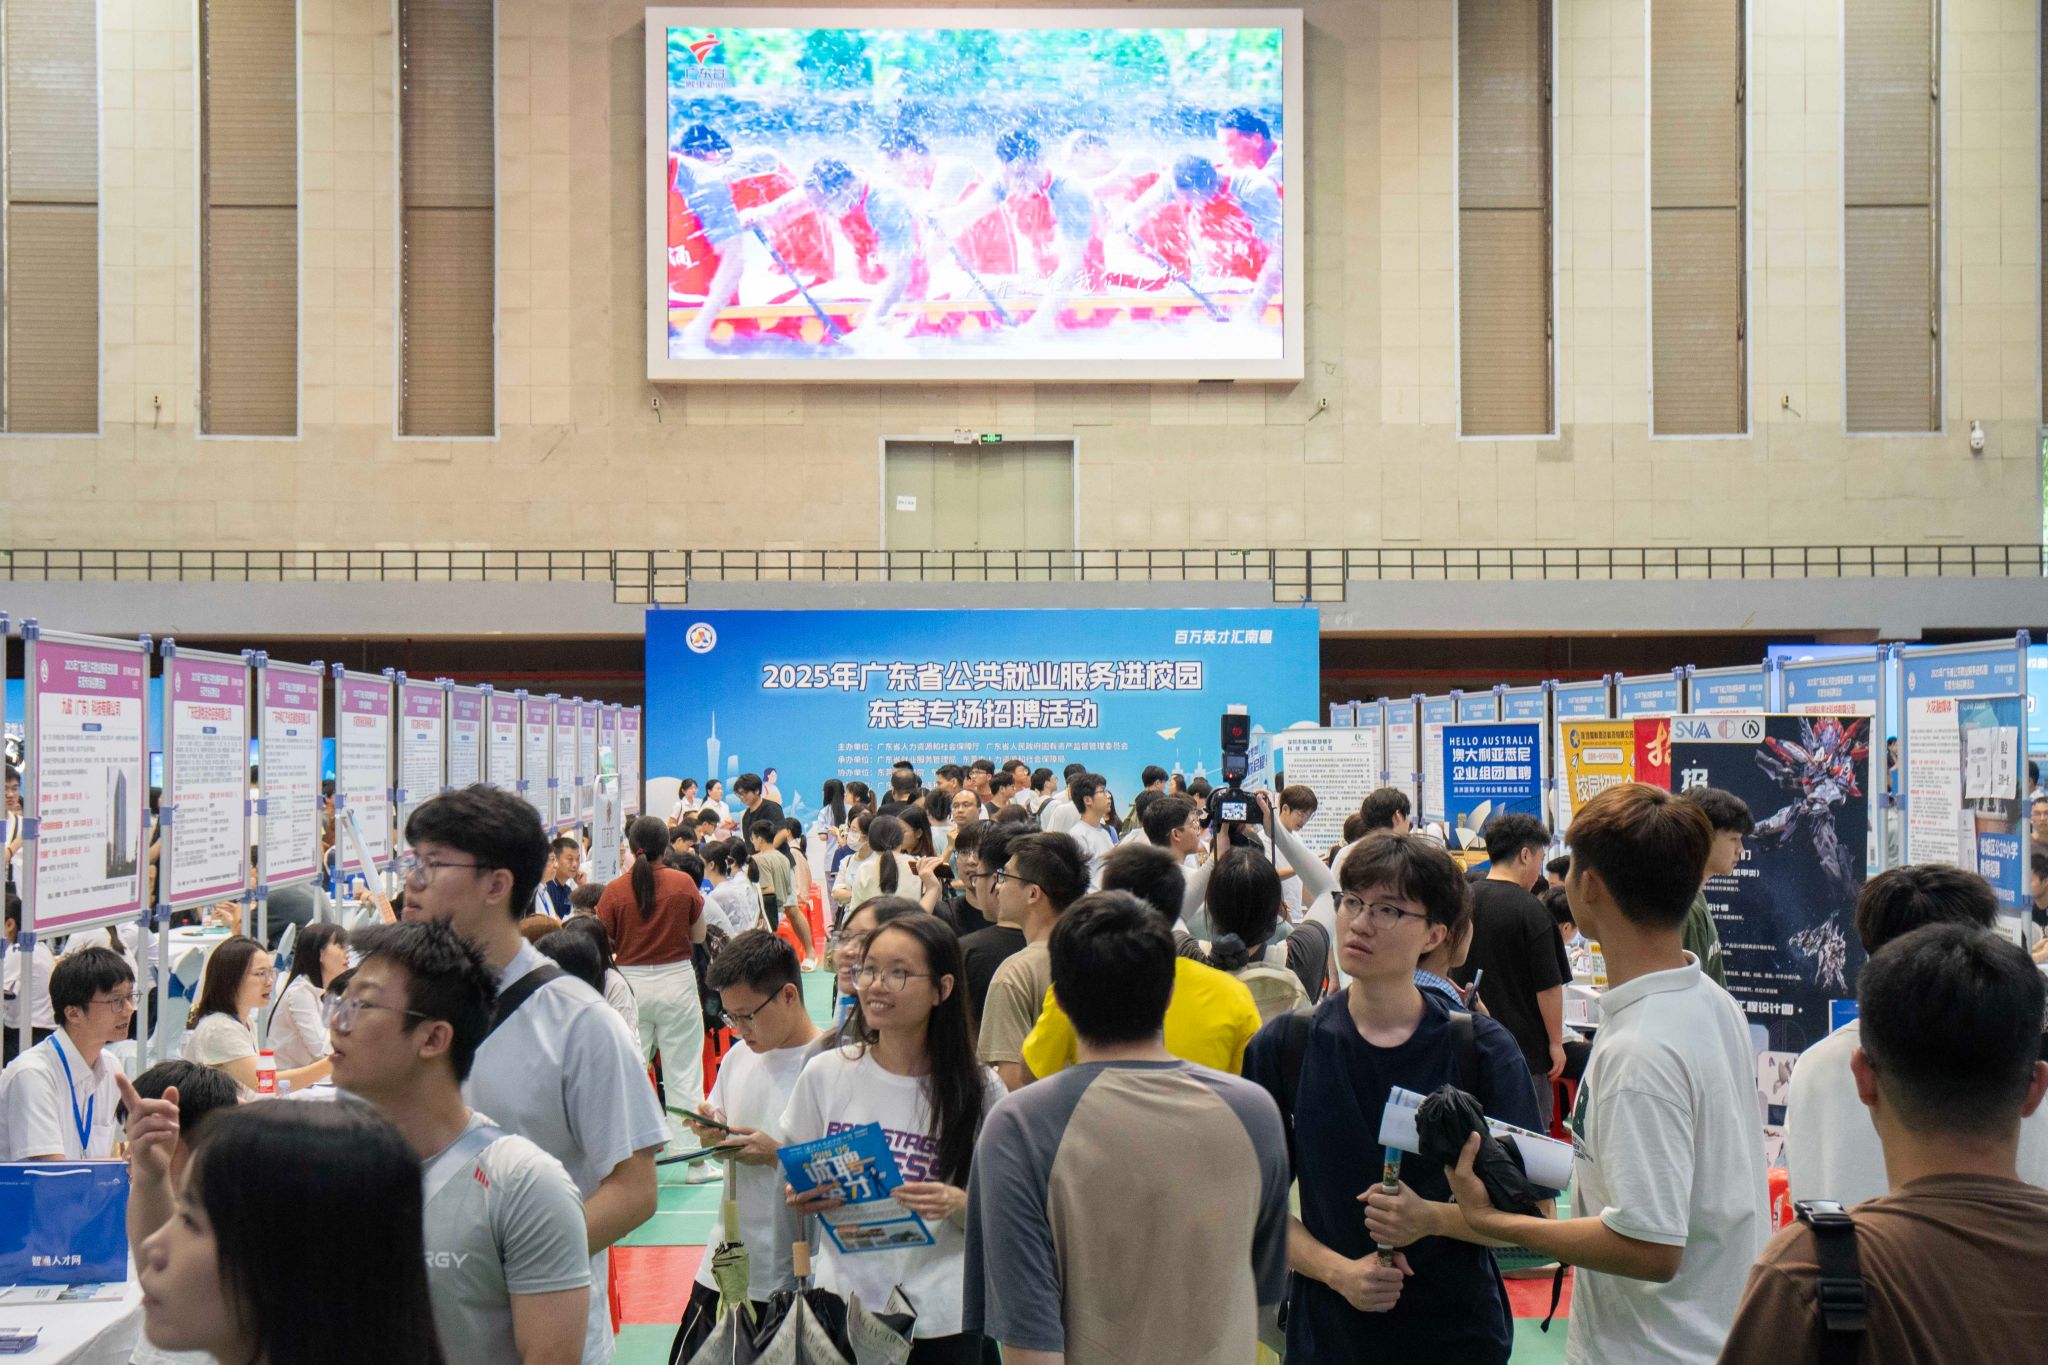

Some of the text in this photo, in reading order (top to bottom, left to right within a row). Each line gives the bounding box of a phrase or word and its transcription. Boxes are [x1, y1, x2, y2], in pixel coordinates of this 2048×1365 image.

[1174, 629, 1273, 645] 百万英才汇南粤
[762, 660, 1202, 692] 2025年广东省公共就业服务进校园
[867, 698, 1099, 729] 东莞专场招聘活动
[1449, 735, 1534, 746] HELLO AUSTRALIA
[1452, 746, 1531, 762] 澳大利亚悉尼
[1452, 766, 1532, 781] 企业组团直聘
[32, 1254, 82, 1267] 智通人才网
